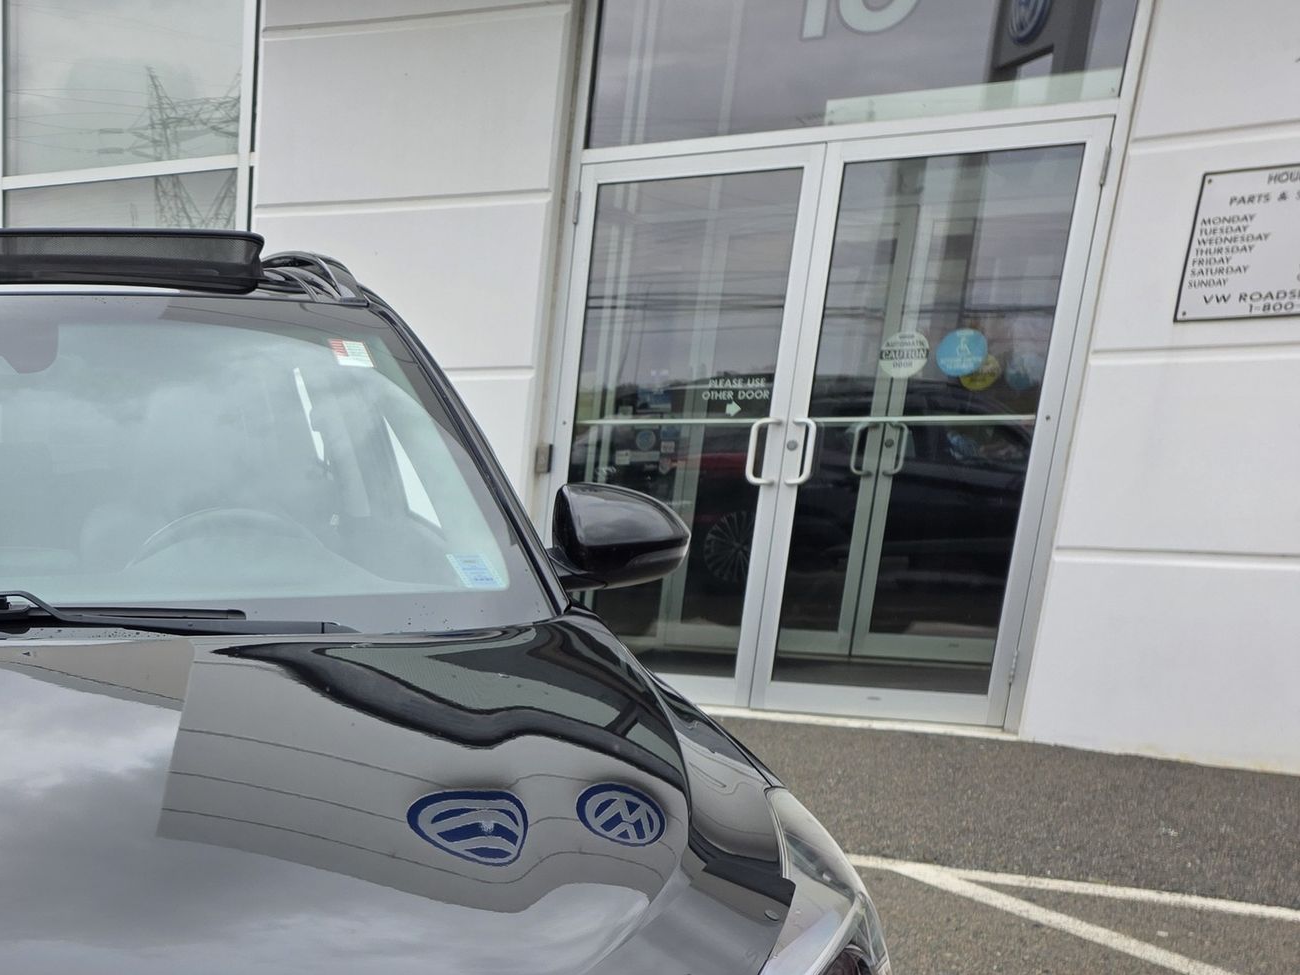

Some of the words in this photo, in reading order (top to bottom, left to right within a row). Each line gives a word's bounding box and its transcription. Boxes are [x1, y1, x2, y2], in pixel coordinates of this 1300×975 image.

[1267, 171, 1300, 184] HOU
[1229, 192, 1270, 206] PARTS
[1277, 191, 1288, 202] &
[1200, 214, 1256, 226] MONDAY
[1200, 225, 1249, 236] TUESDAY
[1197, 232, 1271, 246] WEDNESDAY
[1195, 244, 1255, 256] THURSDAY
[1192, 256, 1232, 267] FRIDAY
[1190, 265, 1249, 277] SATURDAY
[1187, 278, 1229, 289] SUNDAY
[1202, 293, 1231, 305] VW
[881, 349, 927, 360] CAUTION
[708, 378, 743, 389] PLEASE
[746, 377, 767, 388] USE
[701, 389, 734, 401] OTHER
[737, 389, 771, 400] DOOR
